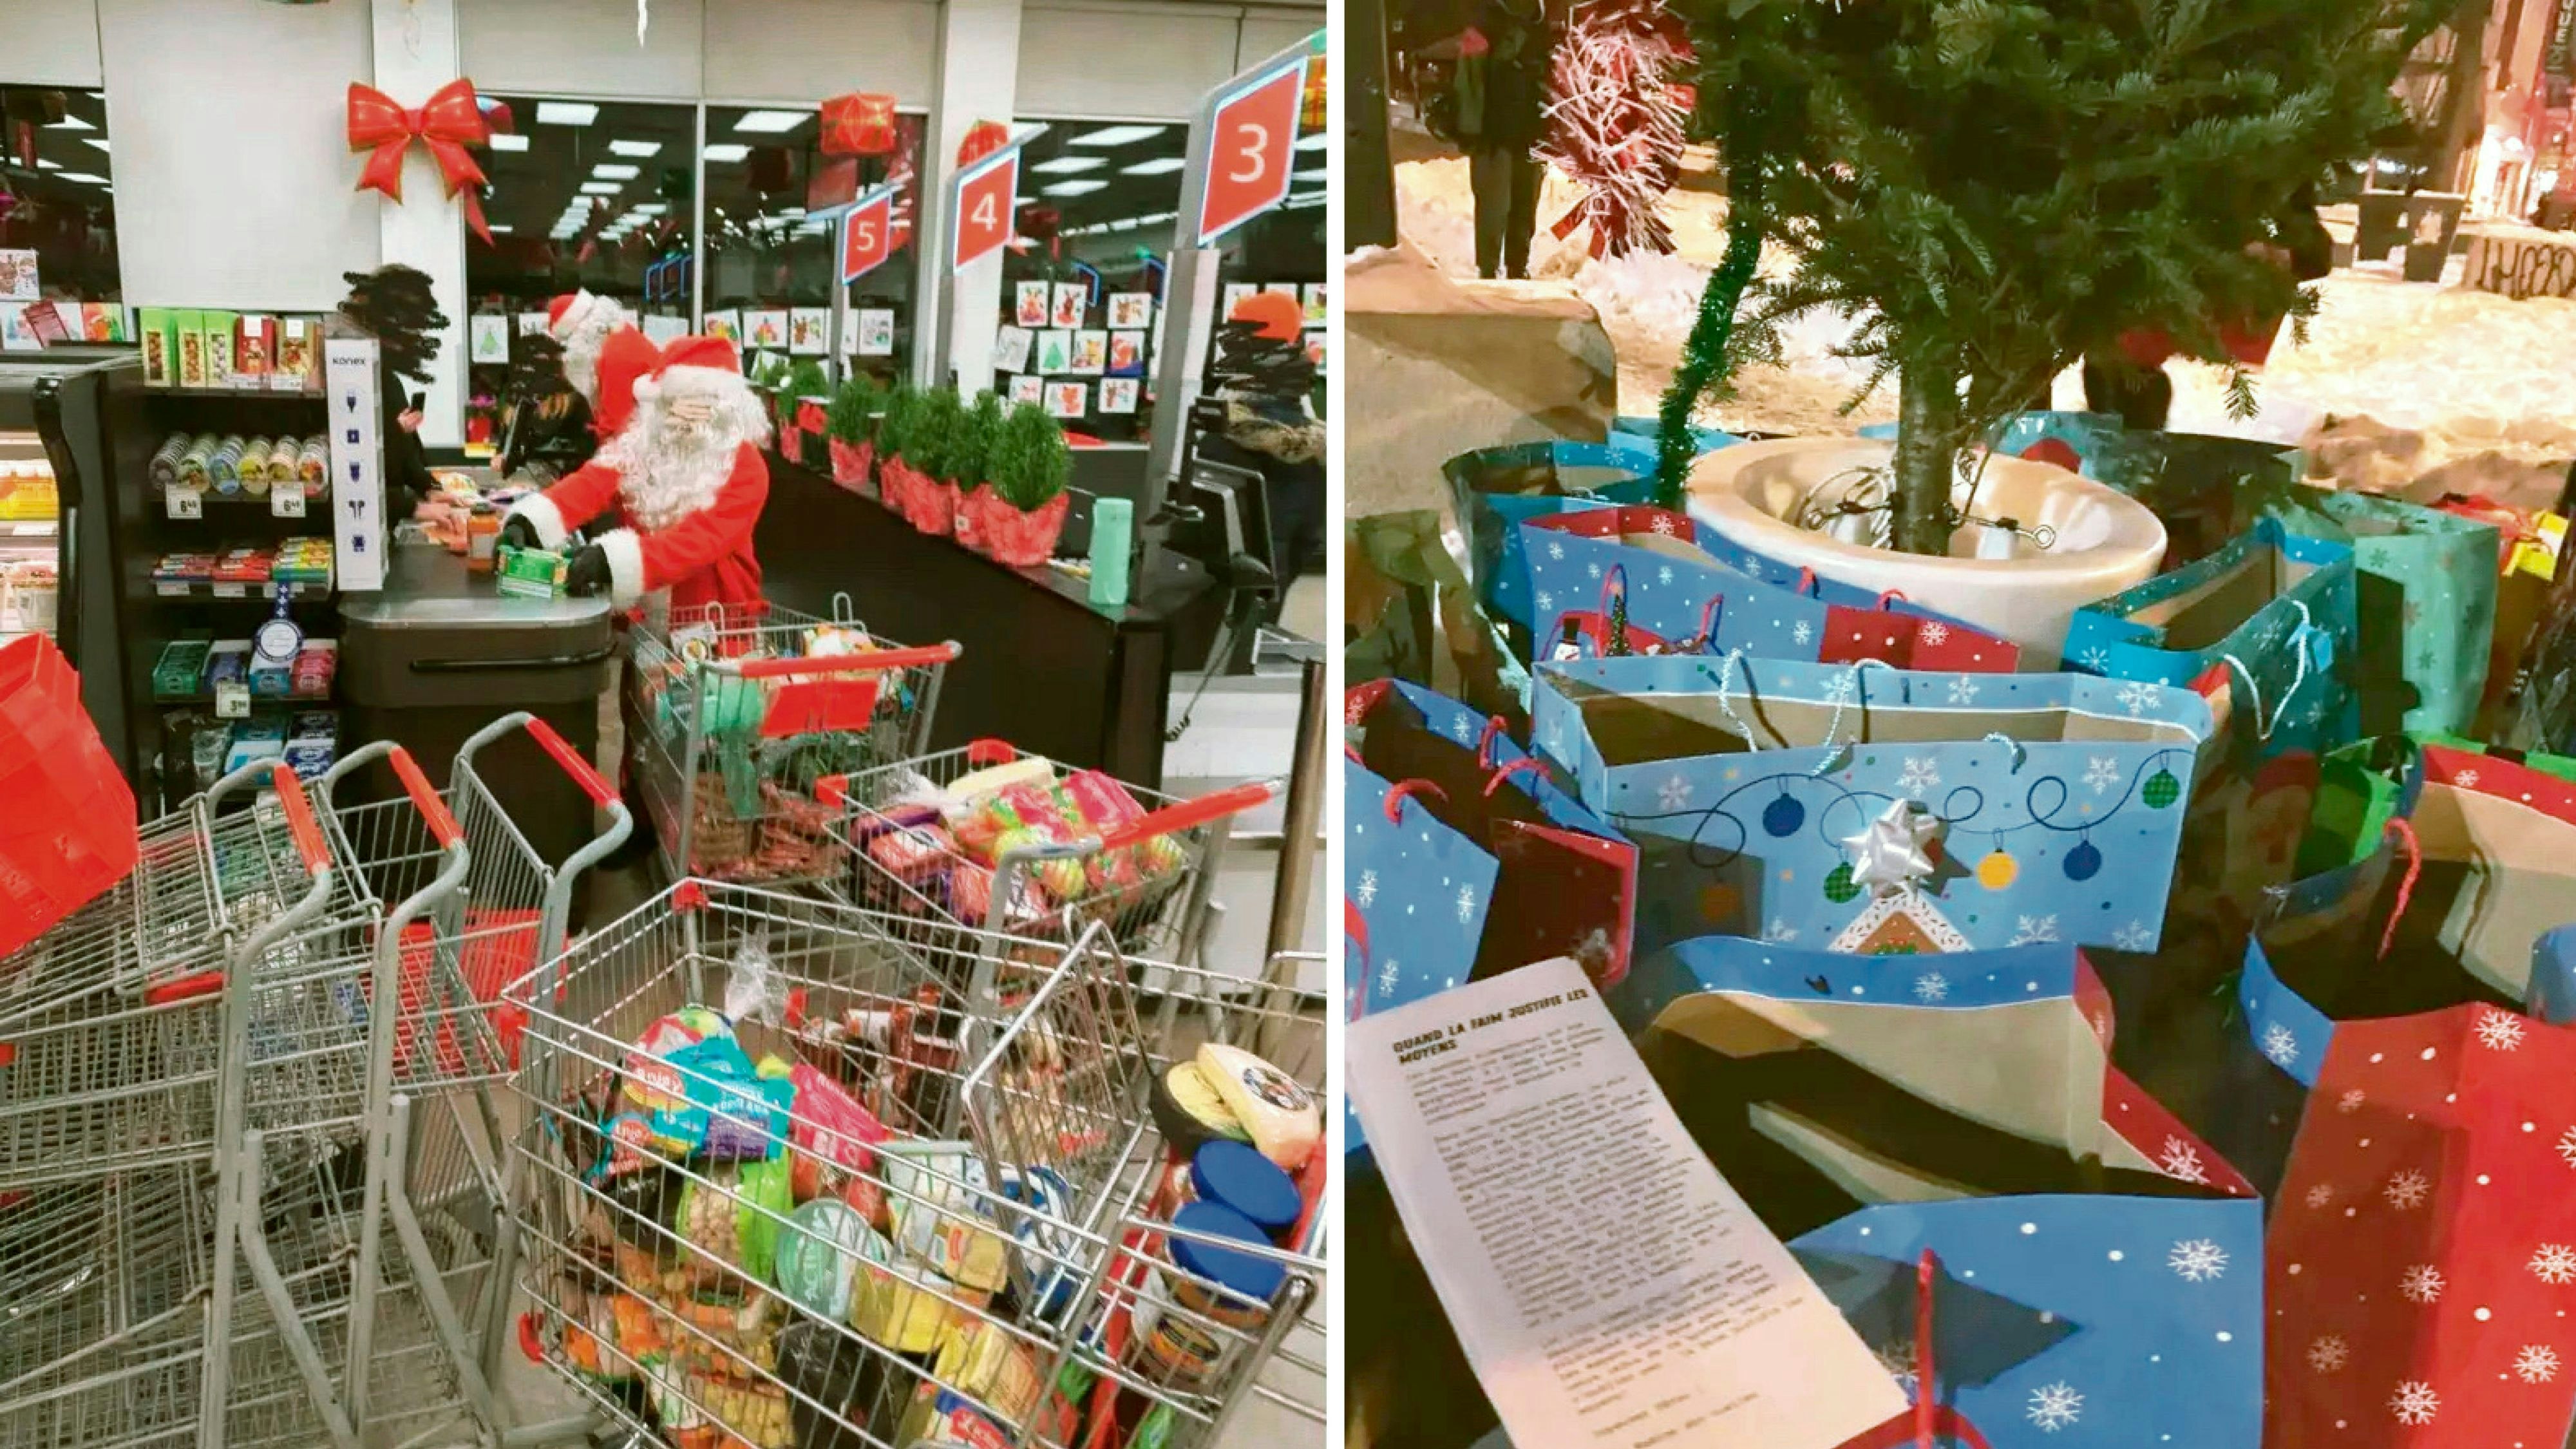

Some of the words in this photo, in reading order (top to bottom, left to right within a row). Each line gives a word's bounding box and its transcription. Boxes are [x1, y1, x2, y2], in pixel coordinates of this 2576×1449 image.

[1229, 123, 1268, 183] 3
[971, 192, 997, 231] 4
[856, 221, 876, 251] 5
[1393, 1030, 1443, 1052] QUAND
[1448, 1023, 1466, 1036] LA
[1470, 1012, 1503, 1029] FAIM
[1566, 988, 1588, 1001] LES
[1399, 1039, 1457, 1063] MOYENS
